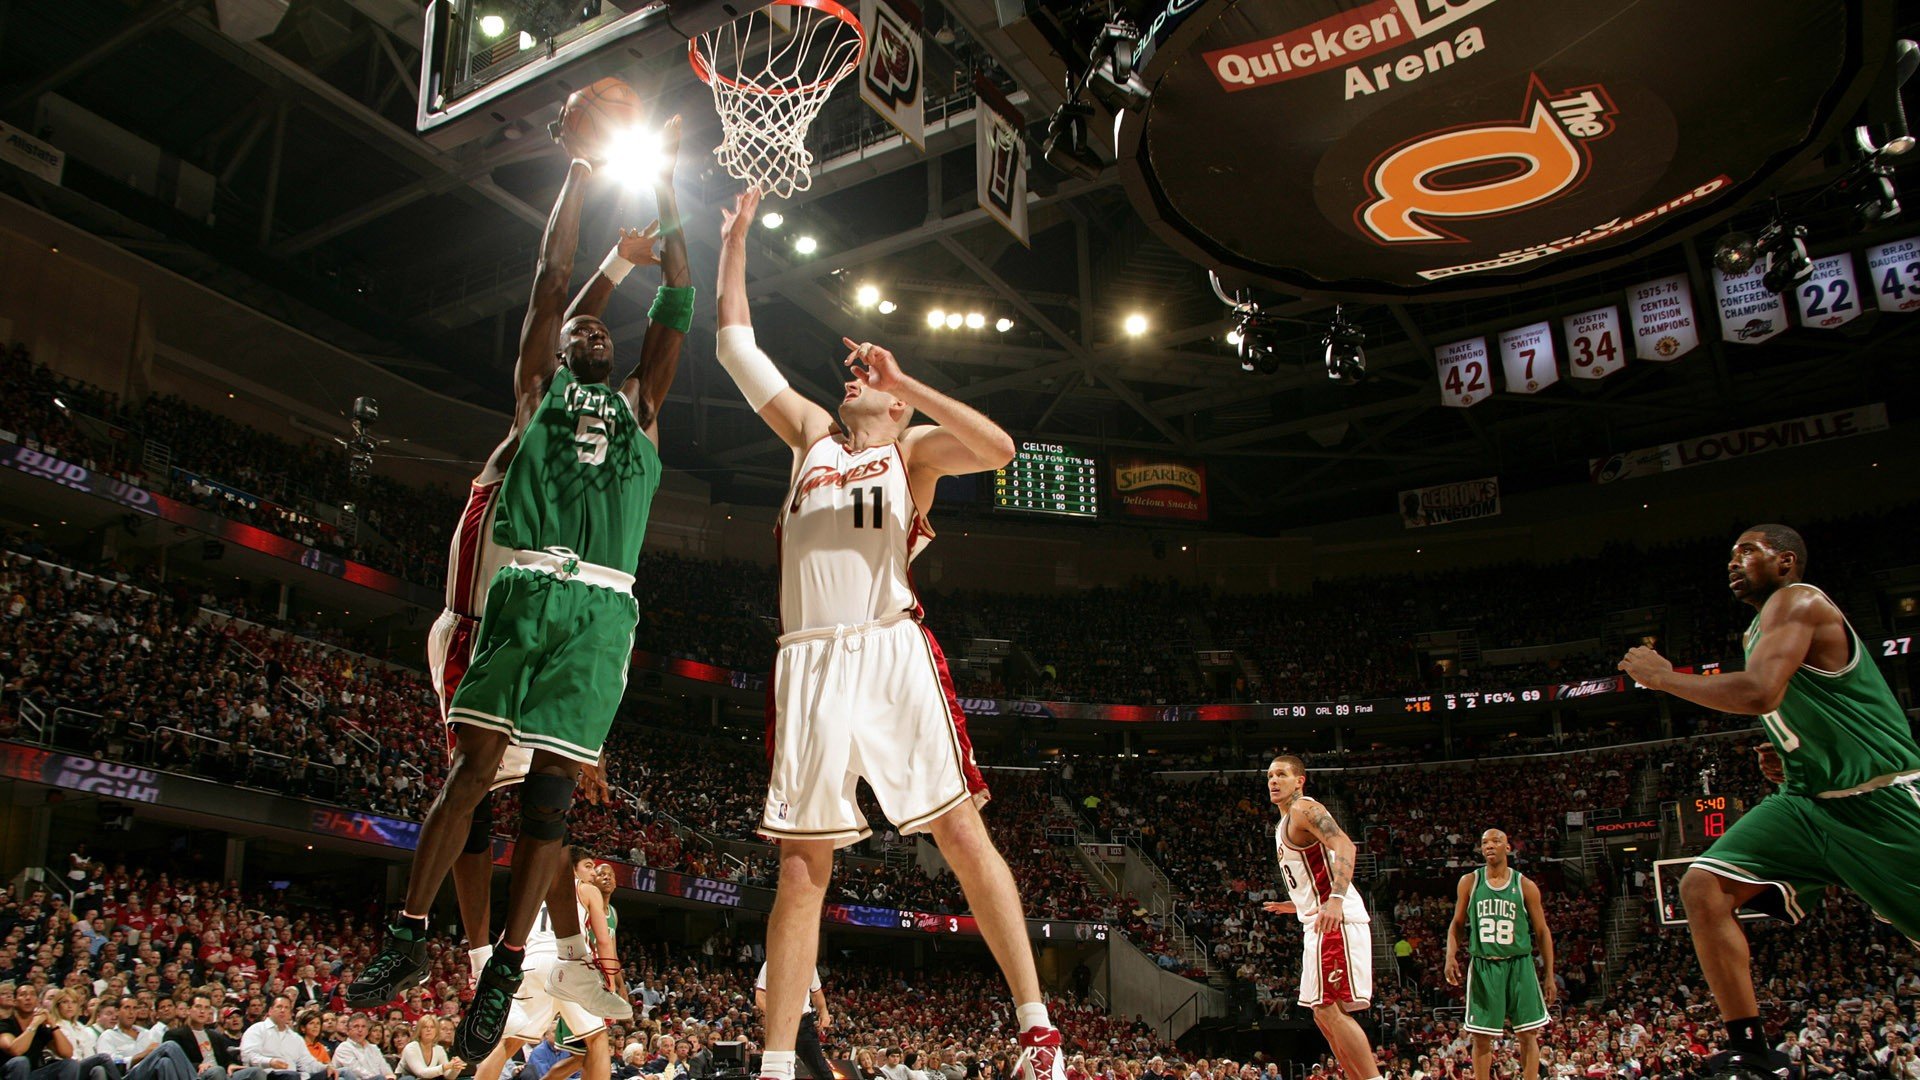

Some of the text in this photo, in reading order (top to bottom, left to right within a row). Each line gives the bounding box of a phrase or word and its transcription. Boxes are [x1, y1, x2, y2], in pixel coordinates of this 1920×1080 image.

[1217, 13, 1402, 85] Quicken
[1345, 27, 1486, 100] Arena
[1550, 91, 1604, 138] The
[6, 133, 59, 167] Allstate
[1364, 99, 1580, 242] Q
[1882, 242, 1914, 257] BRAD
[1812, 259, 1840, 272] ARRY
[1870, 249, 1920, 269] DAUGHERT
[1812, 268, 1843, 281] ANCE
[1881, 261, 1920, 300] 43
[1637, 281, 1679, 300] 1975-76
[1726, 279, 1764, 295] EASTER
[1640, 296, 1680, 313] CENTRAL
[1803, 279, 1853, 318] 22
[1643, 307, 1682, 324] DIVISION
[1725, 299, 1779, 320] CHAMPIONS
[1573, 312, 1608, 326] AUSTIN
[1578, 322, 1605, 334] CARR
[1639, 317, 1690, 337] CHAMPIONS
[1449, 343, 1472, 355] NATE
[1510, 336, 1541, 350] SMITH
[1573, 331, 1617, 368] 34
[1439, 349, 1484, 366] THURMOND
[1519, 349, 1536, 380] 7
[1445, 361, 1485, 395] 42
[575, 415, 609, 466] 5
[1023, 442, 1063, 453] CELTICS
[1676, 411, 1858, 466] LOUDVILLE
[15, 447, 88, 482] BUD
[1019, 452, 1031, 460] RB
[1120, 469, 1196, 488] SHEARER'S
[1123, 495, 1198, 510] Delicious Snacks
[1421, 481, 1497, 509] LEBRON'S
[850, 486, 882, 529] 11
[1424, 499, 1496, 524] KINGDOM
[1883, 637, 1911, 656] 27
[1447, 699, 1456, 710] 5
[1467, 698, 1476, 709] 2
[1484, 690, 1541, 704] FG% 69
[1273, 704, 1373, 717] DET 90 ORL 89 Final
[1405, 701, 1431, 712] +18
[1695, 797, 1725, 812] 5:40
[1596, 820, 1656, 833] PONTIAC
[1704, 813, 1725, 837] 18
[1477, 899, 1516, 919] CELTICS
[901, 919, 911, 928] 69
[949, 918, 958, 932] 3
[1042, 923, 1050, 937] 1
[1479, 917, 1514, 945] 28
[1095, 932, 1106, 940] 43
